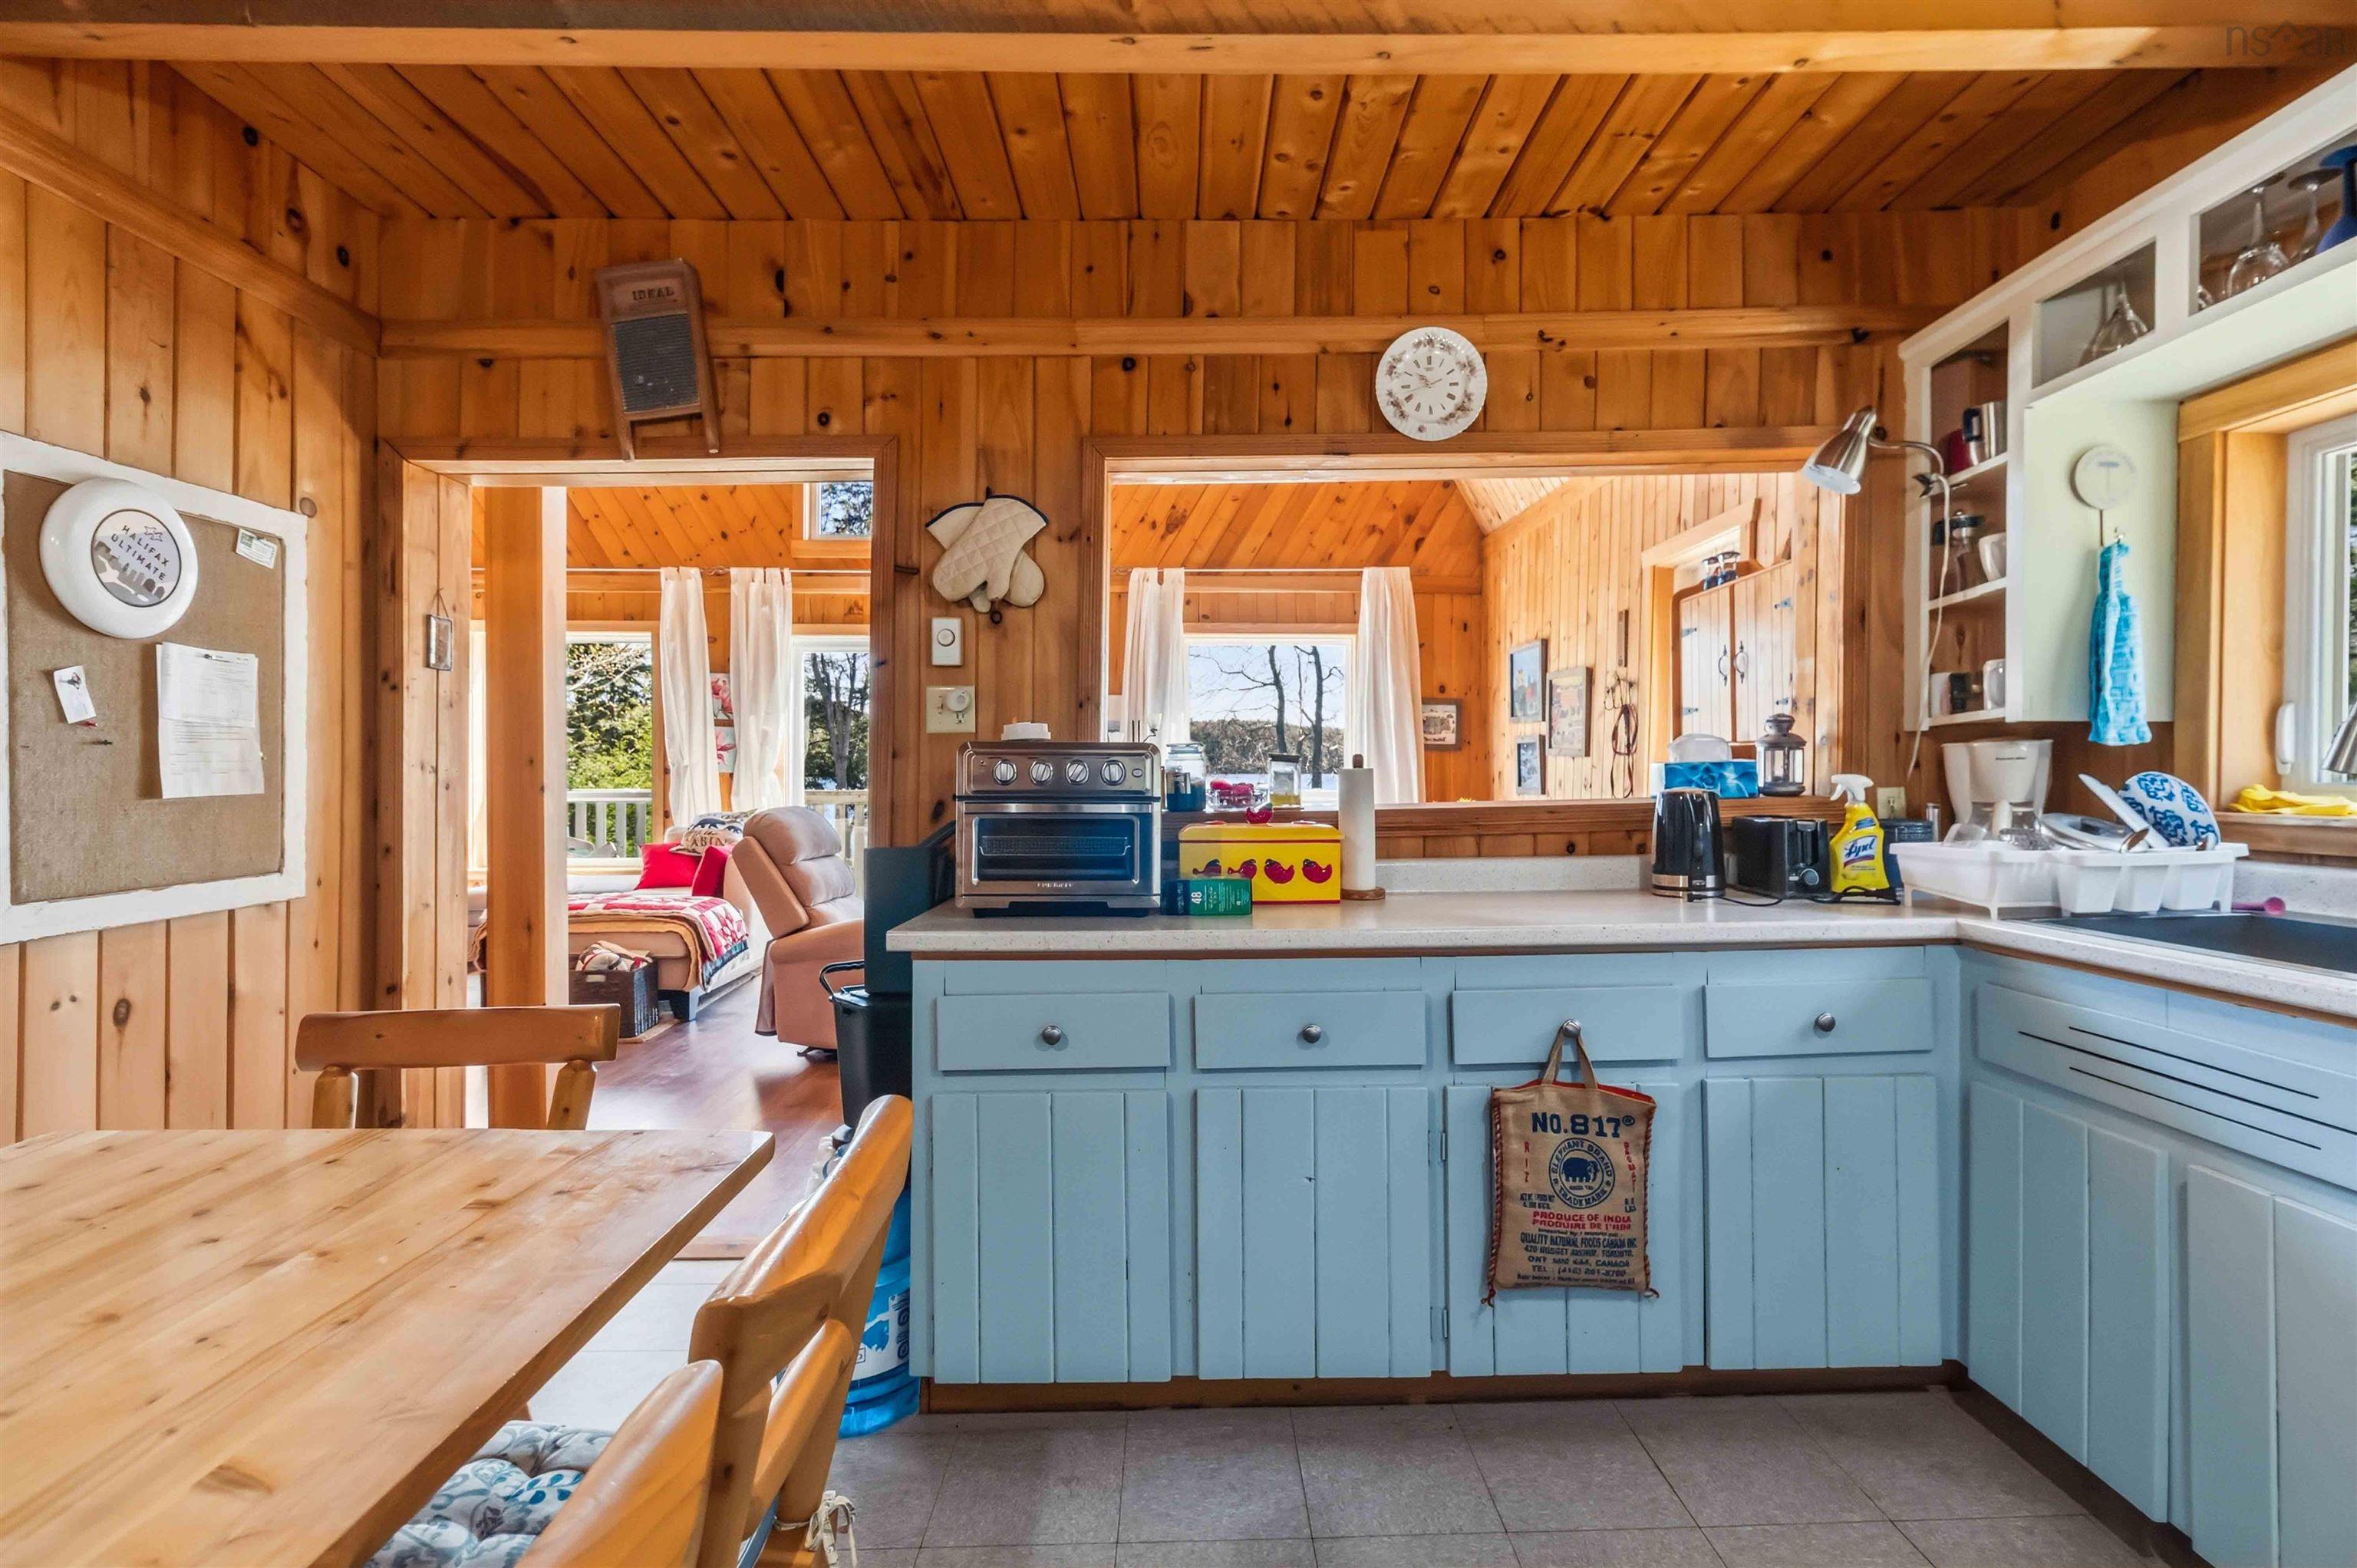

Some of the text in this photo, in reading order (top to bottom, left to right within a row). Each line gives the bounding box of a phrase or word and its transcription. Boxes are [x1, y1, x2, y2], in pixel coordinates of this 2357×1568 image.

[632, 286, 675, 301] IDEAL
[123, 525, 170, 566] HALIFAX
[110, 533, 166, 581] ULTIMATE
[1191, 891, 1202, 904] 48
[1551, 1140, 1613, 1178] ELEPHANT BRAND
[1558, 1185, 1584, 1207] TRADE
[1532, 1211, 1633, 1224] PRODUCE OF INDIA
[1520, 1232, 1548, 1244] QUALITY
